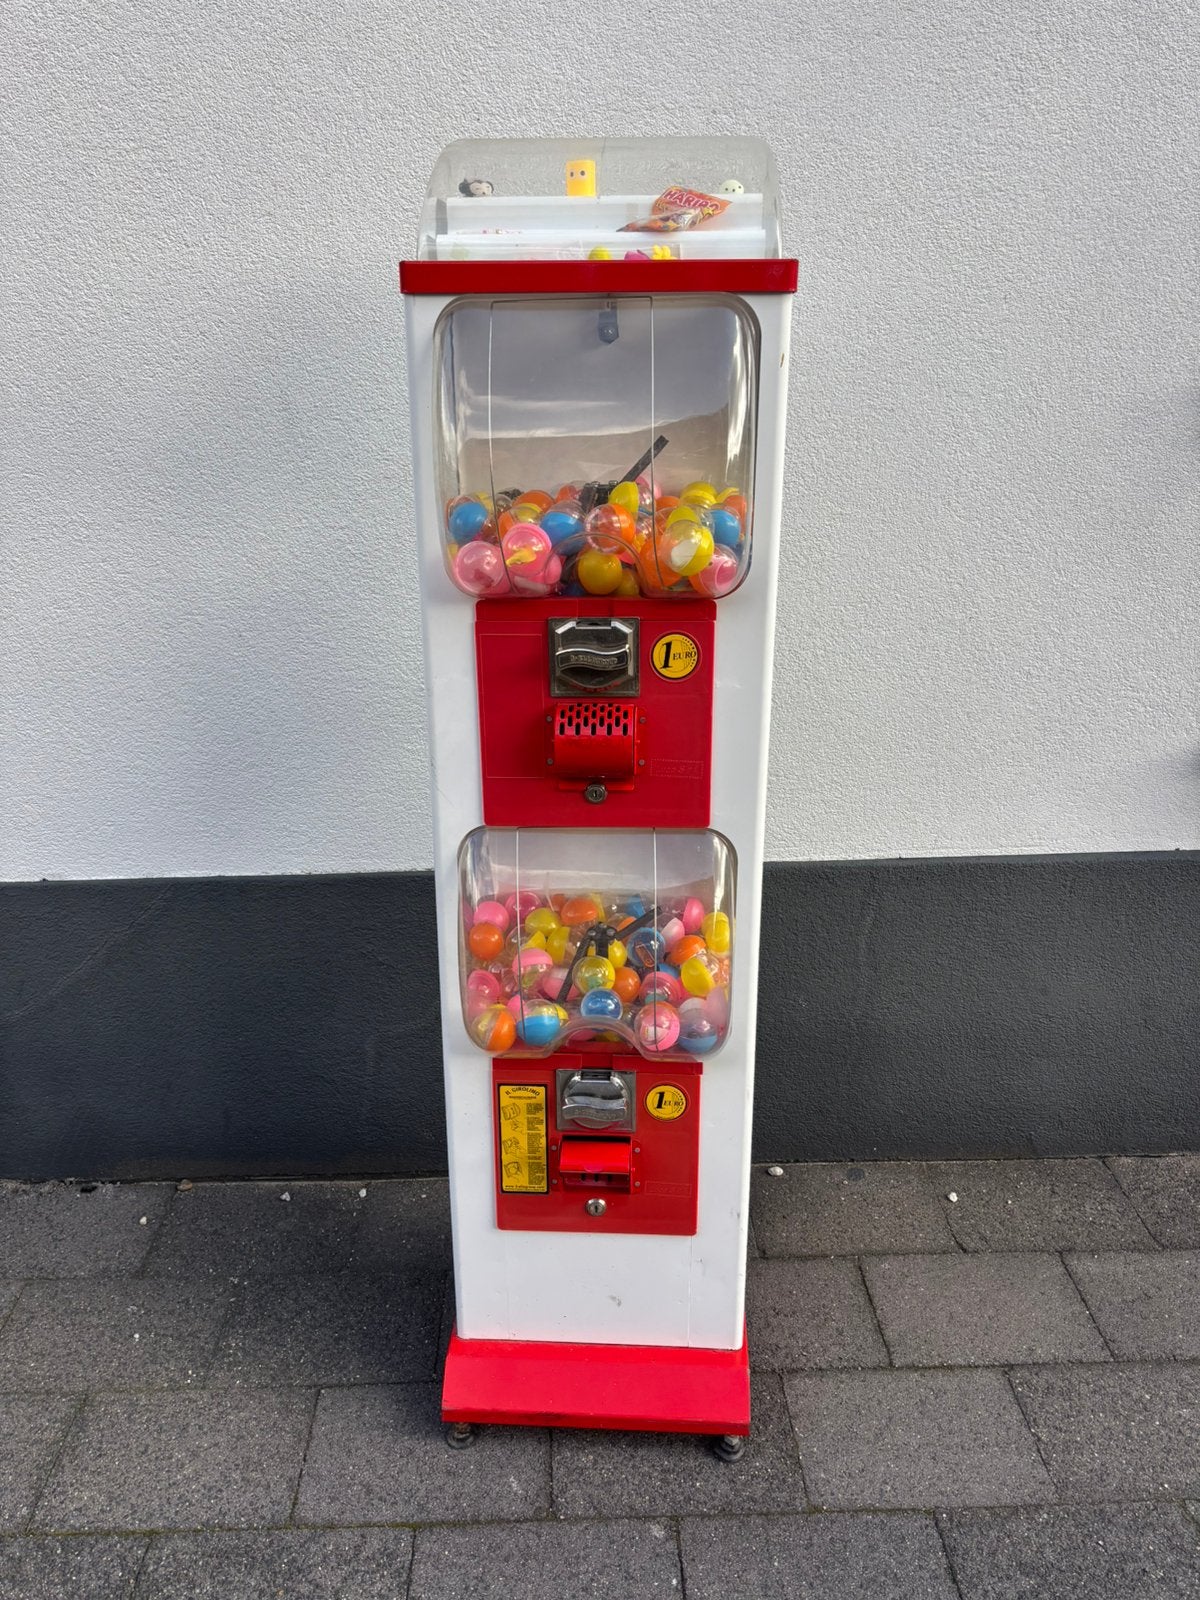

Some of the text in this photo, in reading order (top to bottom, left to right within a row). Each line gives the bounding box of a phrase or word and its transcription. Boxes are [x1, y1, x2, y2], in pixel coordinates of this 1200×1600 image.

[660, 641, 697, 669] 1 EURO
[654, 1091, 665, 1109] 1
